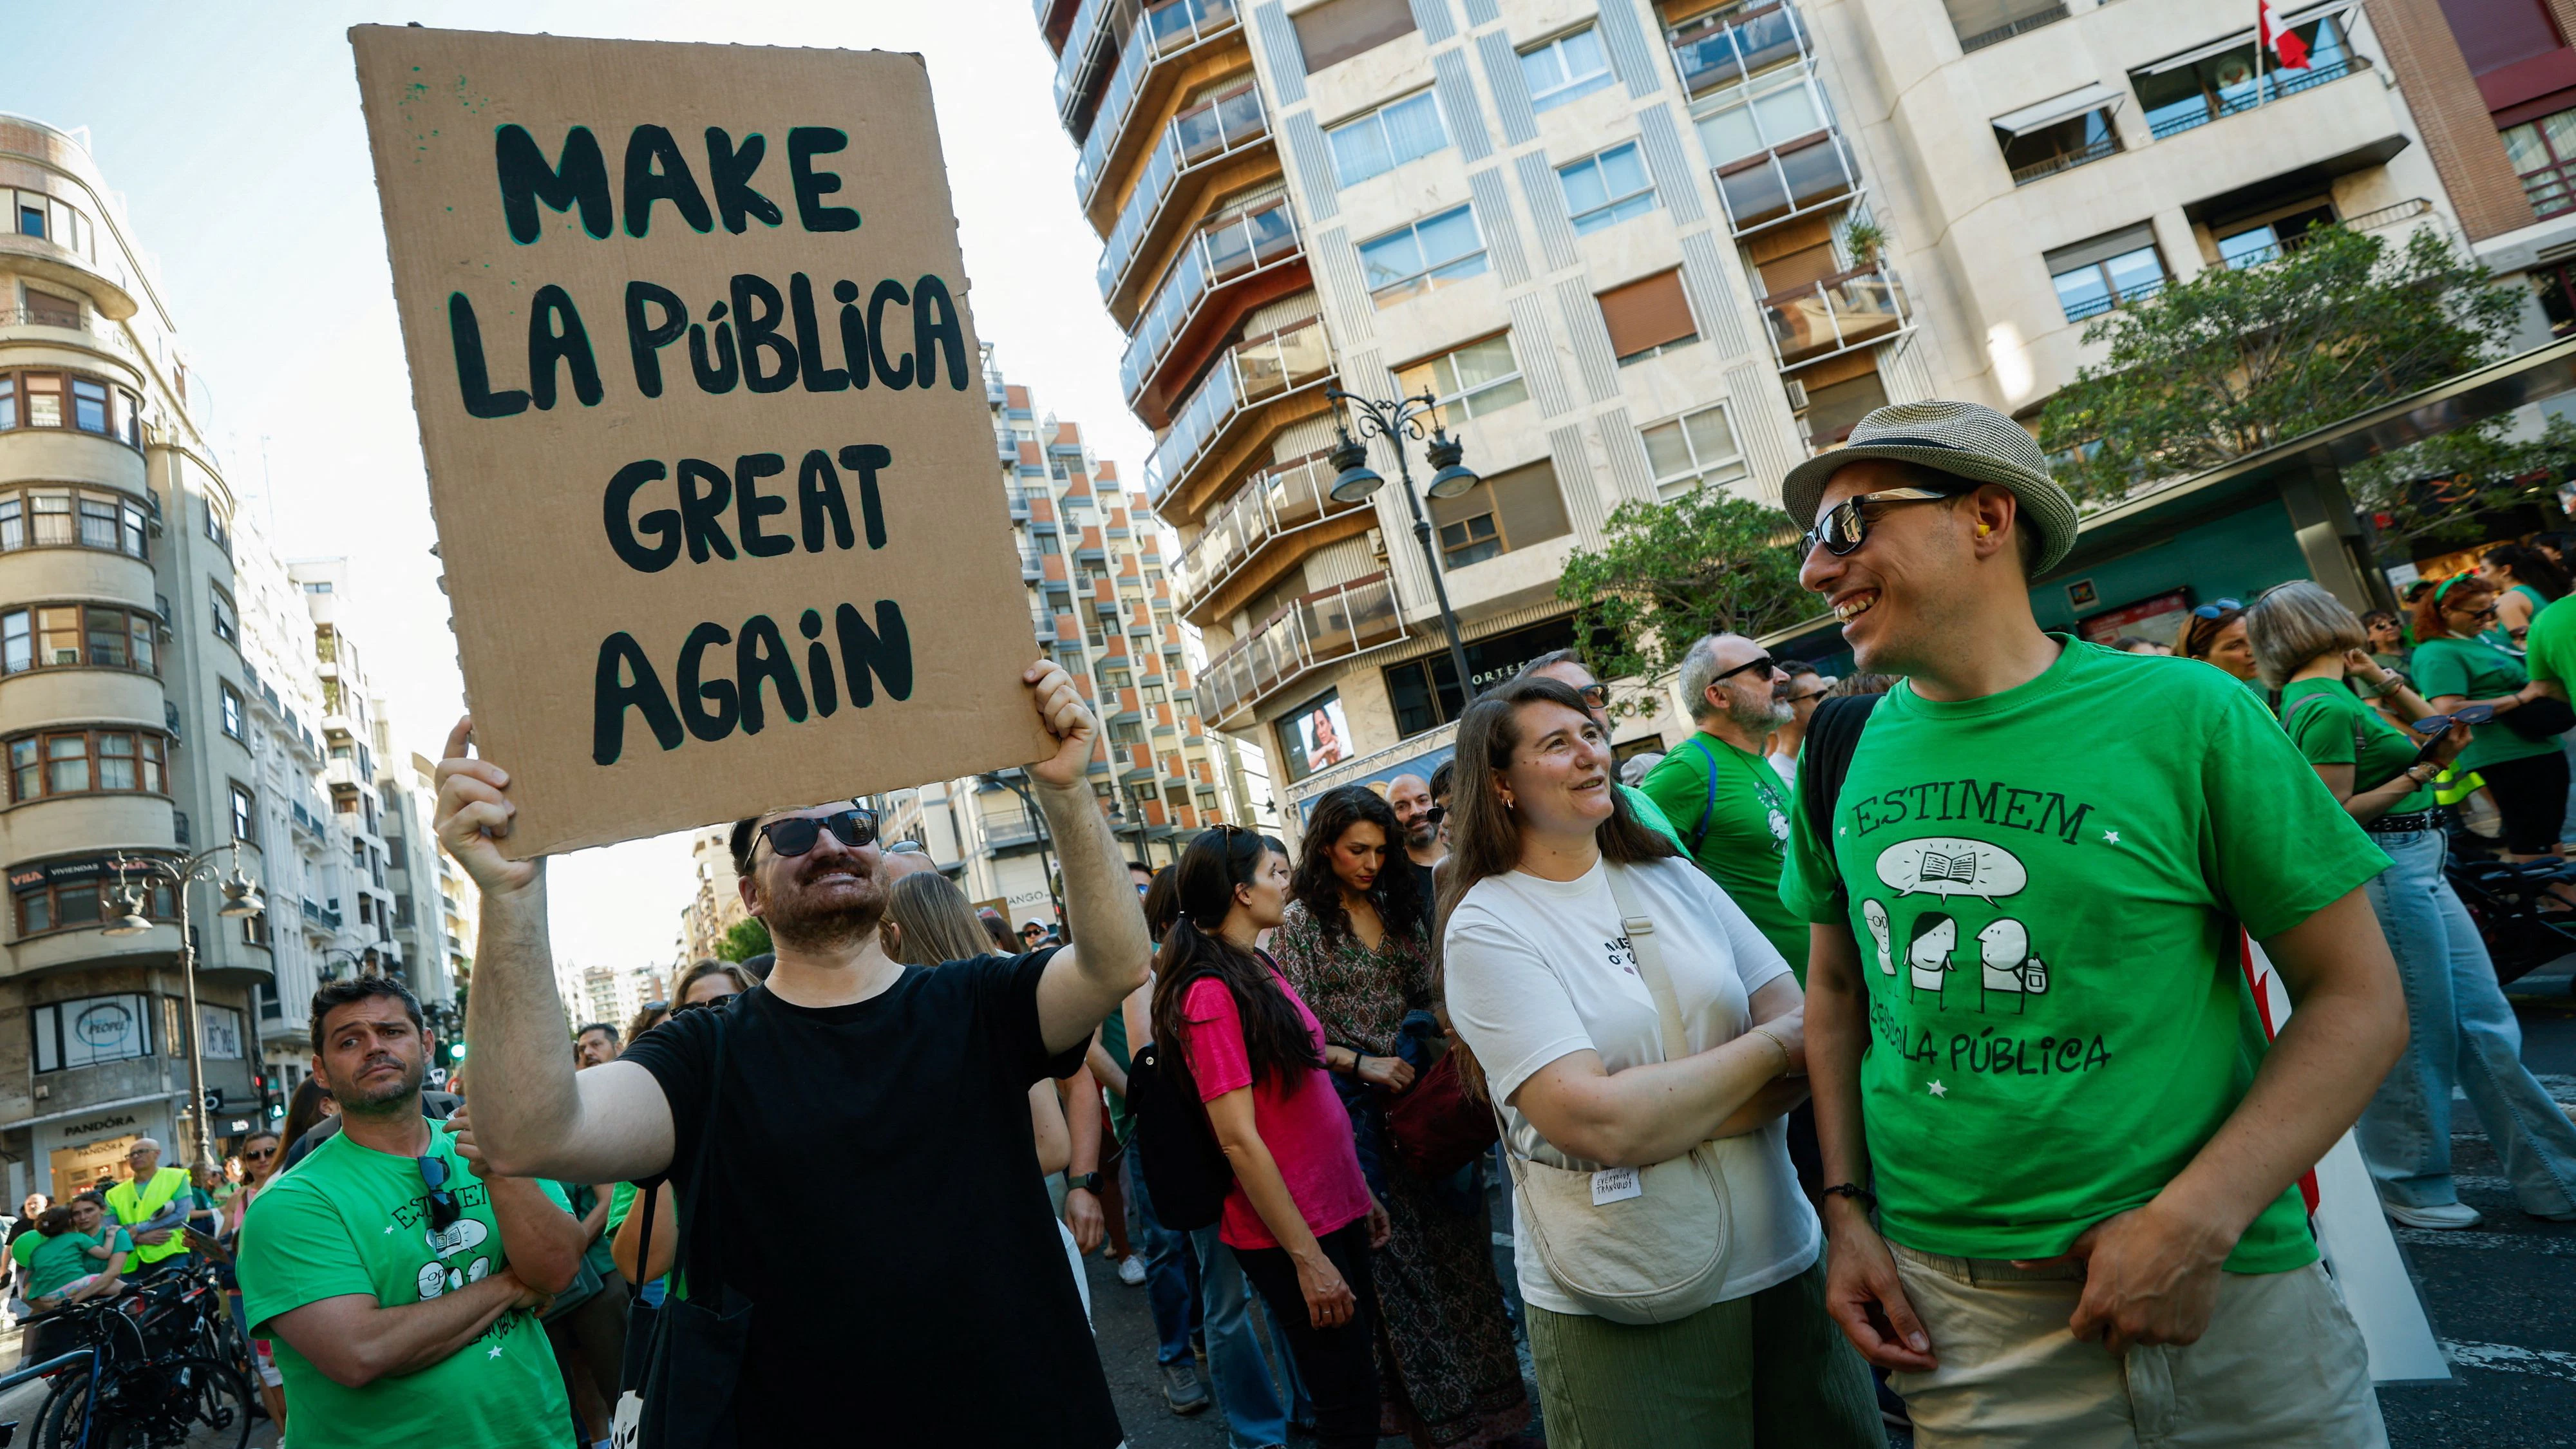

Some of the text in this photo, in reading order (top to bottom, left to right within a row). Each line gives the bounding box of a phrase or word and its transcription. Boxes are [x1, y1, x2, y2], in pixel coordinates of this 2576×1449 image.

[495, 124, 862, 245] MAKE
[448, 283, 604, 419] LA
[603, 444, 891, 573] GREAT
[1852, 779, 2096, 846] ESTIMEM
[10, 860, 149, 886] VILA VIVIENDAS VLA
[1008, 891, 1043, 905] ANGO
[1597, 1171, 1630, 1186] EVERYBODY
